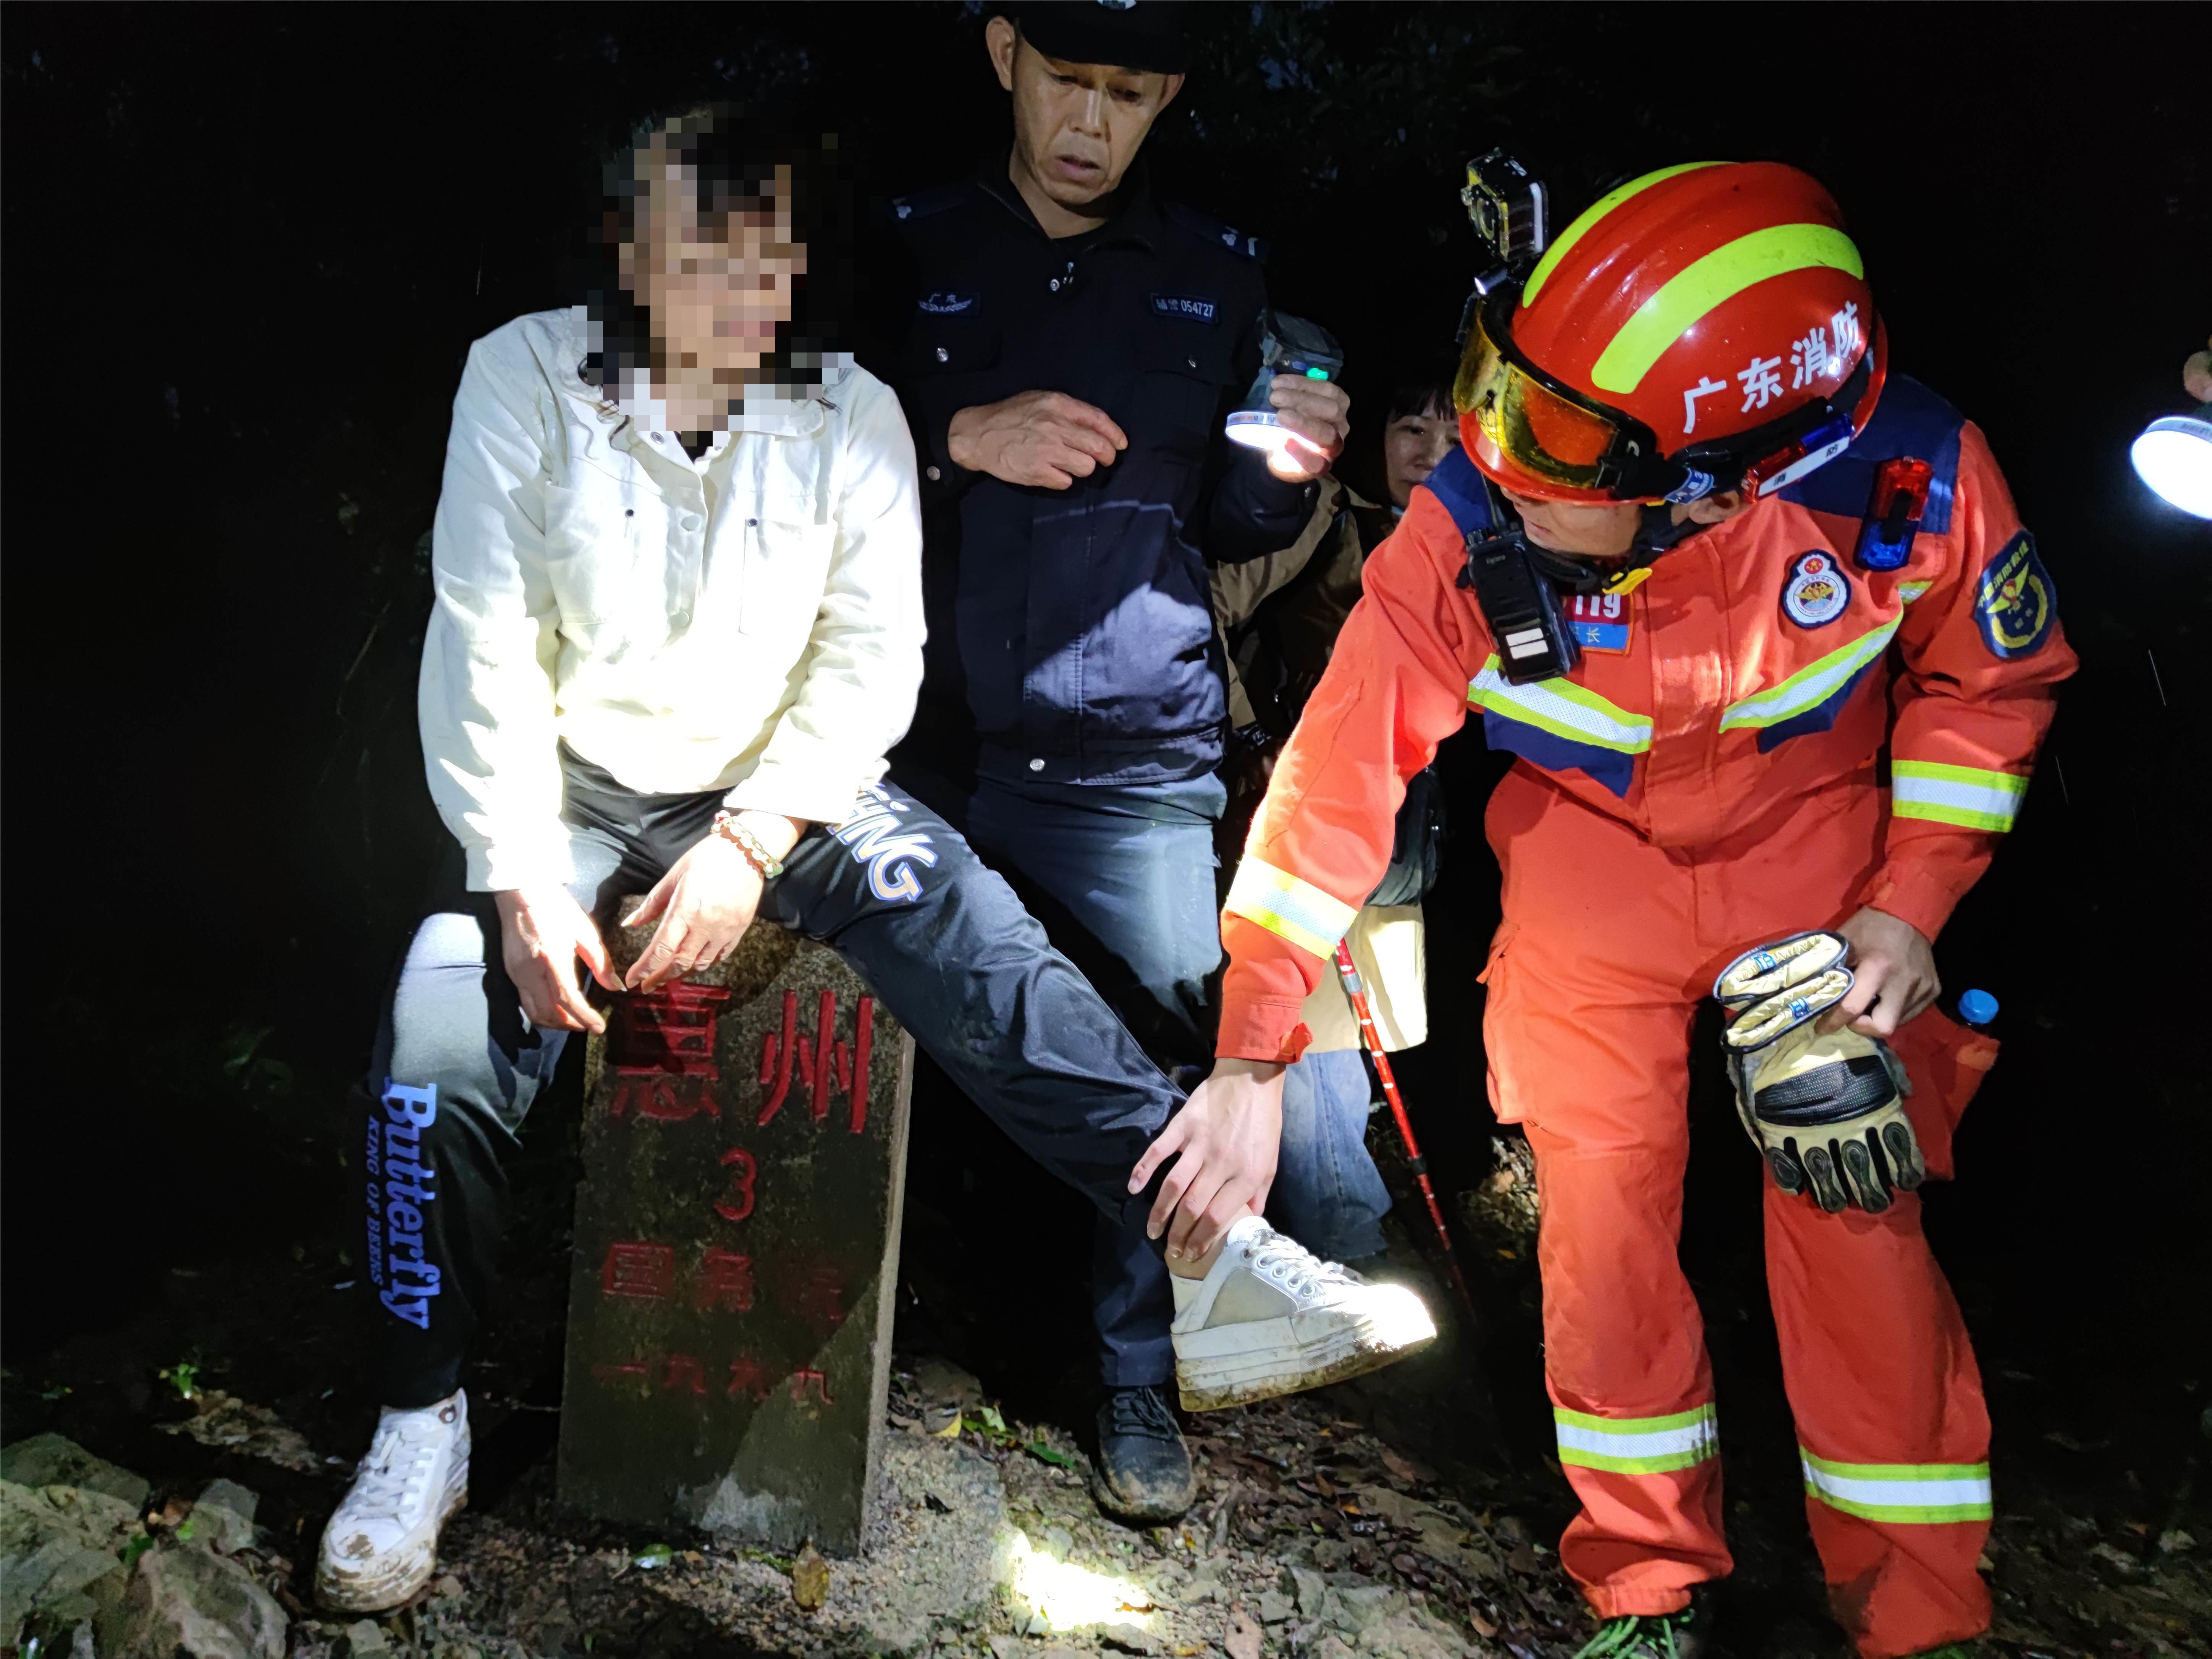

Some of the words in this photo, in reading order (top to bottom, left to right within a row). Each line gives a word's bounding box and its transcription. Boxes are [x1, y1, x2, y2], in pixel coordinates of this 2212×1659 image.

[1180, 299, 1214, 319] 054727
[1682, 299, 1861, 434] 广东消防
[1575, 593, 1621, 618] 119
[610, 979, 873, 1134] 惠州
[366, 1114, 380, 1175] KING
[366, 1184, 380, 1215] OF
[380, 1076, 441, 1329] Butterfly
[713, 1147, 758, 1223] 3
[366, 1216, 384, 1287] BEERS
